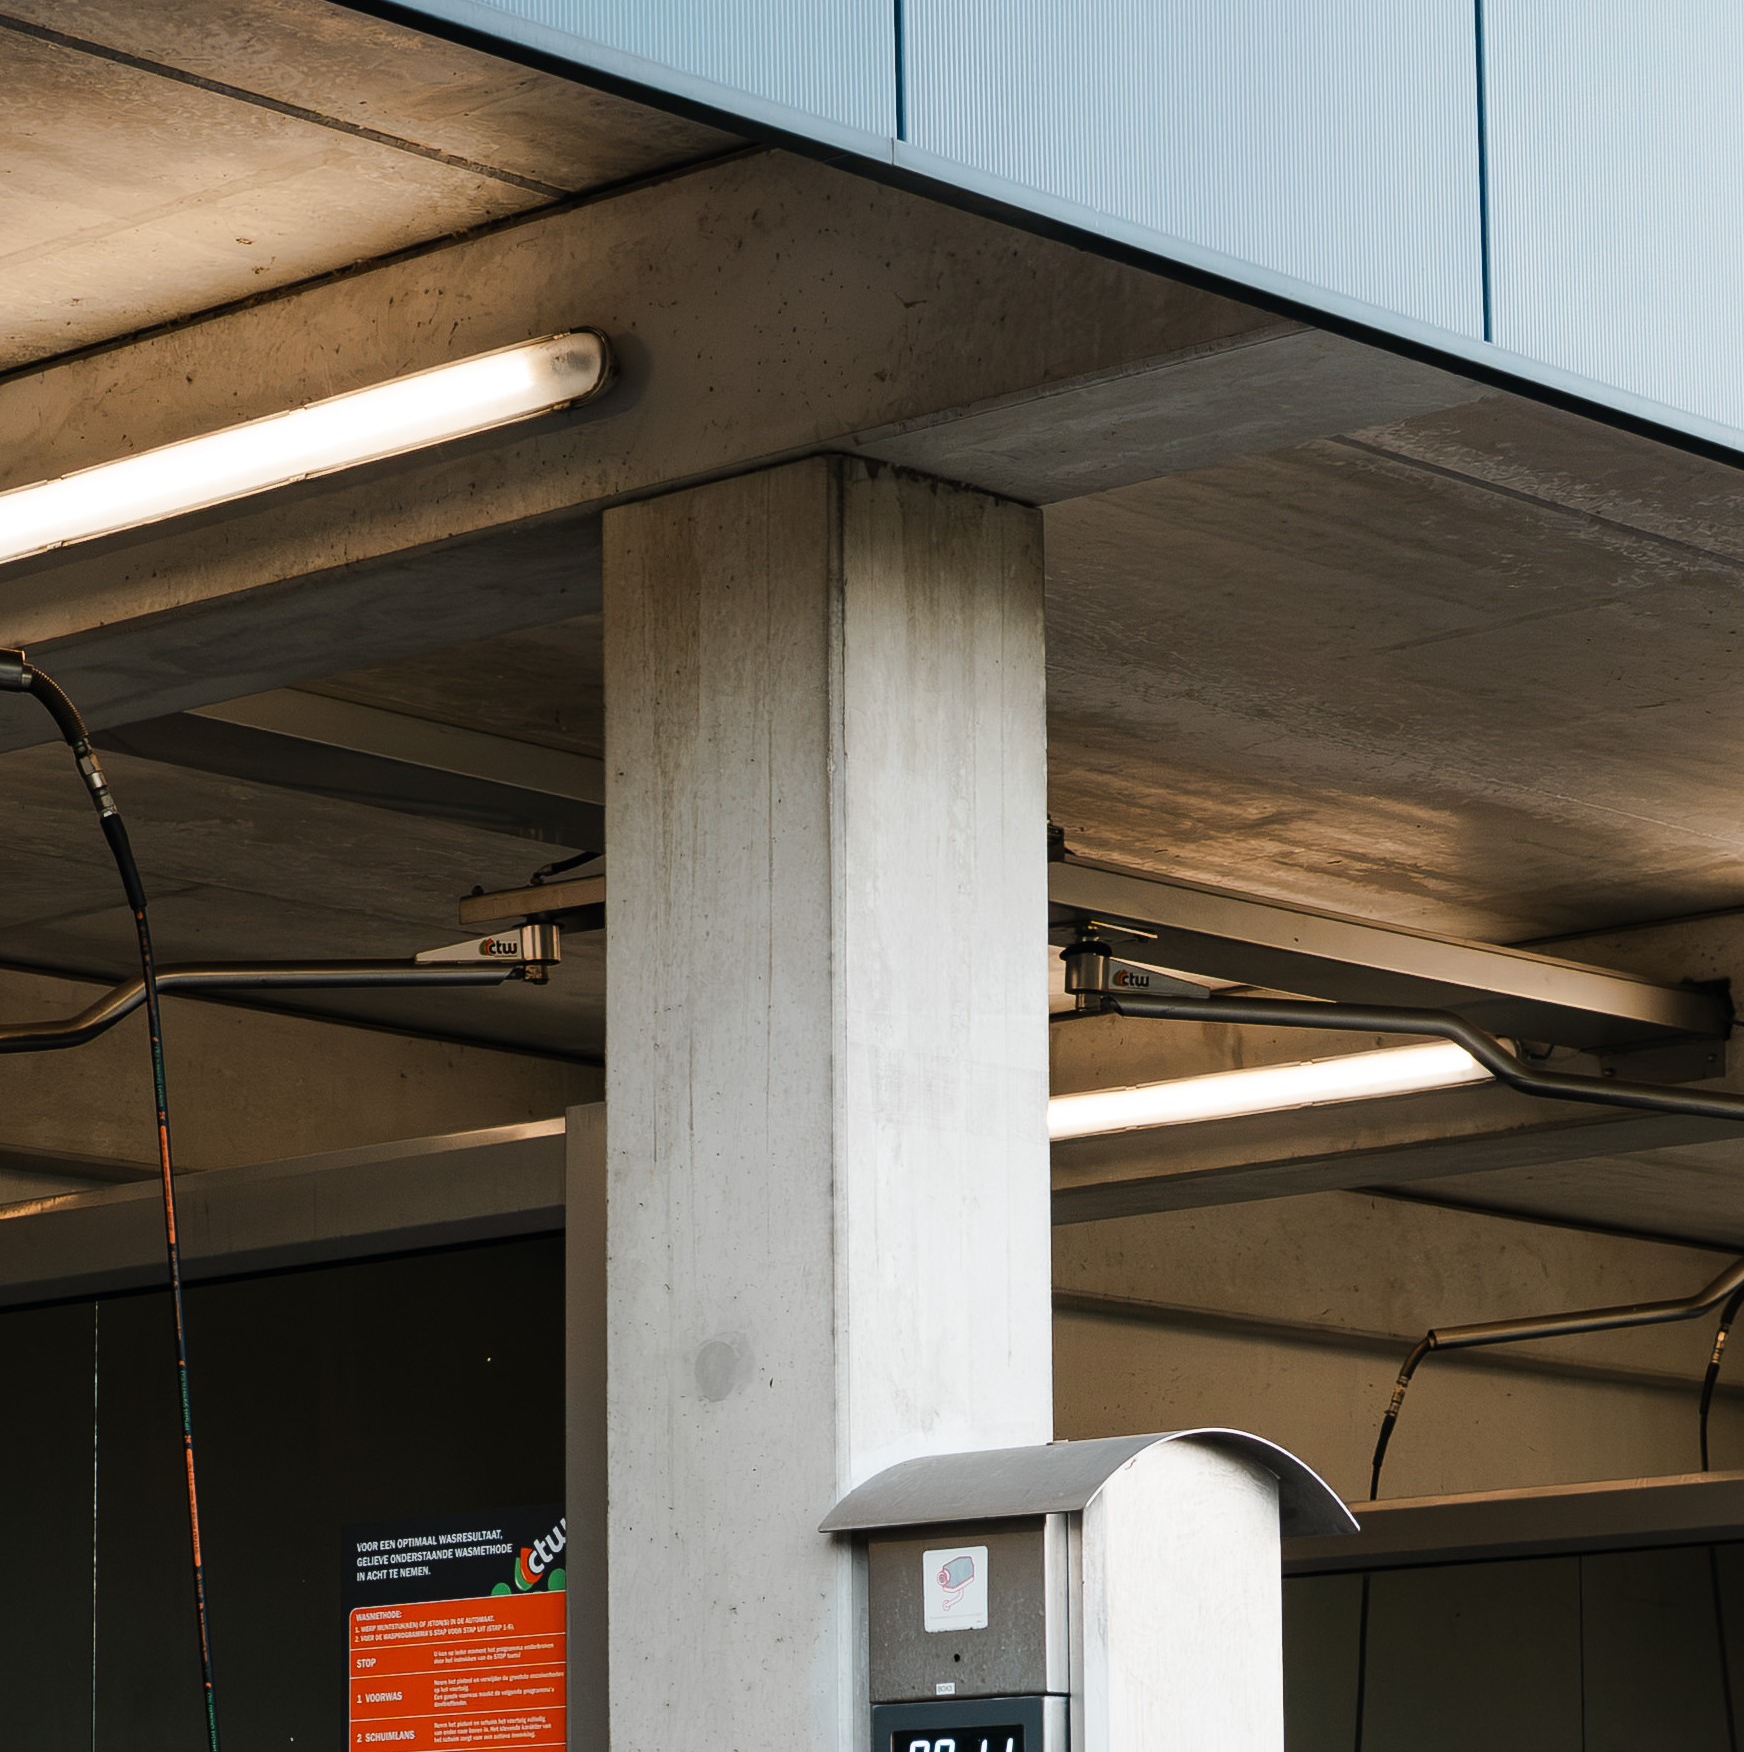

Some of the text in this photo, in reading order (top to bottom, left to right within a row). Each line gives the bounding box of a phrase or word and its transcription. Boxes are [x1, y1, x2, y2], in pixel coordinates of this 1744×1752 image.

[489, 940, 517, 954] ctw
[1122, 970, 1149, 987] ctw
[357, 1529, 503, 1553] VOOR EEN OPTIMAAL WASRESULTAAT,
[357, 1544, 513, 1567] GELIEVE ONDERSTAANDE WASMETHODE
[357, 1566, 431, 1582] IN ACHT TE NEMEN.
[356, 1610, 402, 1621] WASMETHODE:
[357, 1658, 376, 1668] STOP
[357, 1692, 403, 1703] 1 VOORWAS
[357, 1731, 415, 1743] 2 SCHUIMLANS
